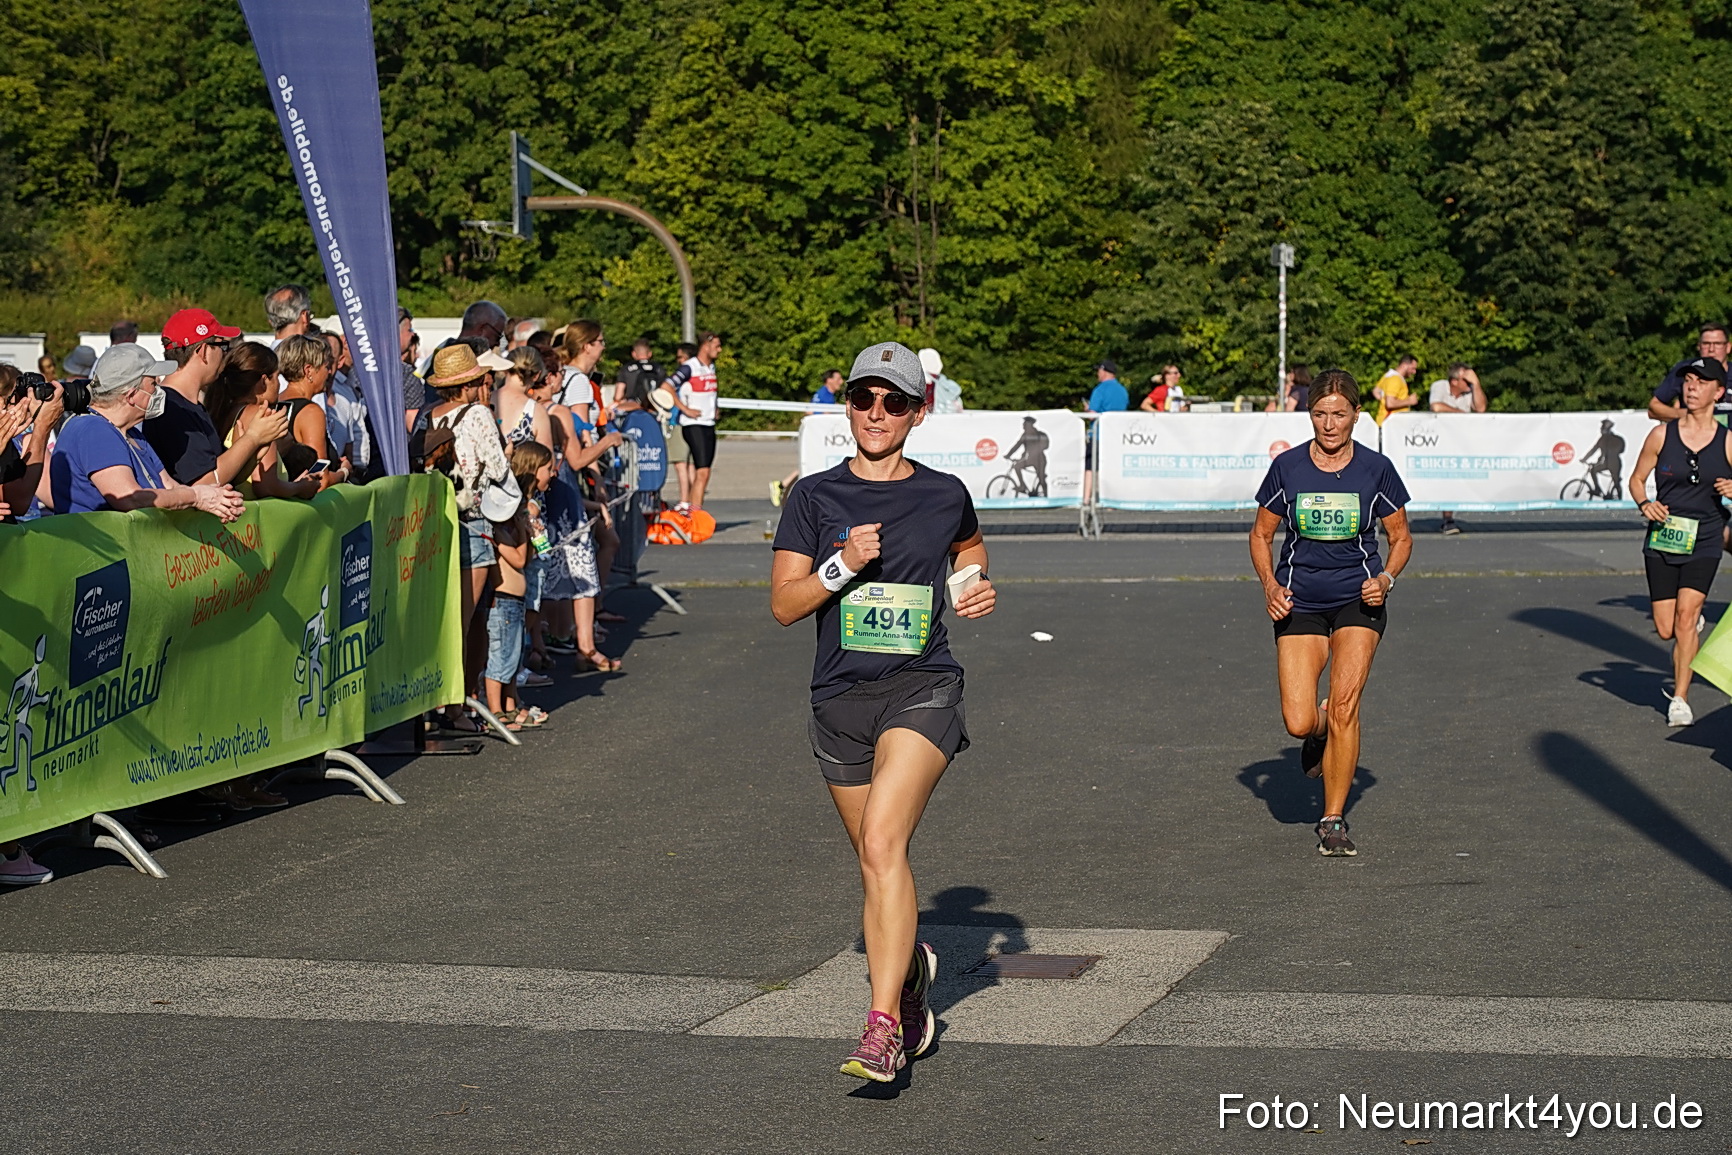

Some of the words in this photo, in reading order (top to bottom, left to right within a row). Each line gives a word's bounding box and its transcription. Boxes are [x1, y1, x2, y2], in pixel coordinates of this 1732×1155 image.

[1122, 433, 1157, 446] NOW
[1404, 434, 1439, 447] NOW
[1124, 455, 1176, 468] E-BIKES
[1179, 455, 1188, 468] &
[1408, 456, 1457, 469] E-BIKES
[1460, 456, 1471, 469] &
[1474, 454, 1554, 470] FAHRRÄDER
[1311, 509, 1345, 525] 956
[1660, 527, 1684, 542] 480
[164, 530, 220, 589] Gesunde
[344, 555, 370, 579] Fischer
[82, 600, 123, 627] Fischer
[845, 612, 855, 636] RUN
[862, 606, 912, 630] 494
[83, 618, 118, 638] AUTOMOBILE
[853, 629, 881, 638] Rummel
[881, 631, 921, 640] Anna-Maria
[920, 613, 929, 646] 2022
[43, 635, 173, 753] firmenlauf
[43, 734, 100, 781] neumarkt
[126, 716, 271, 785] www.firmenlauf-oberpfalz.de
